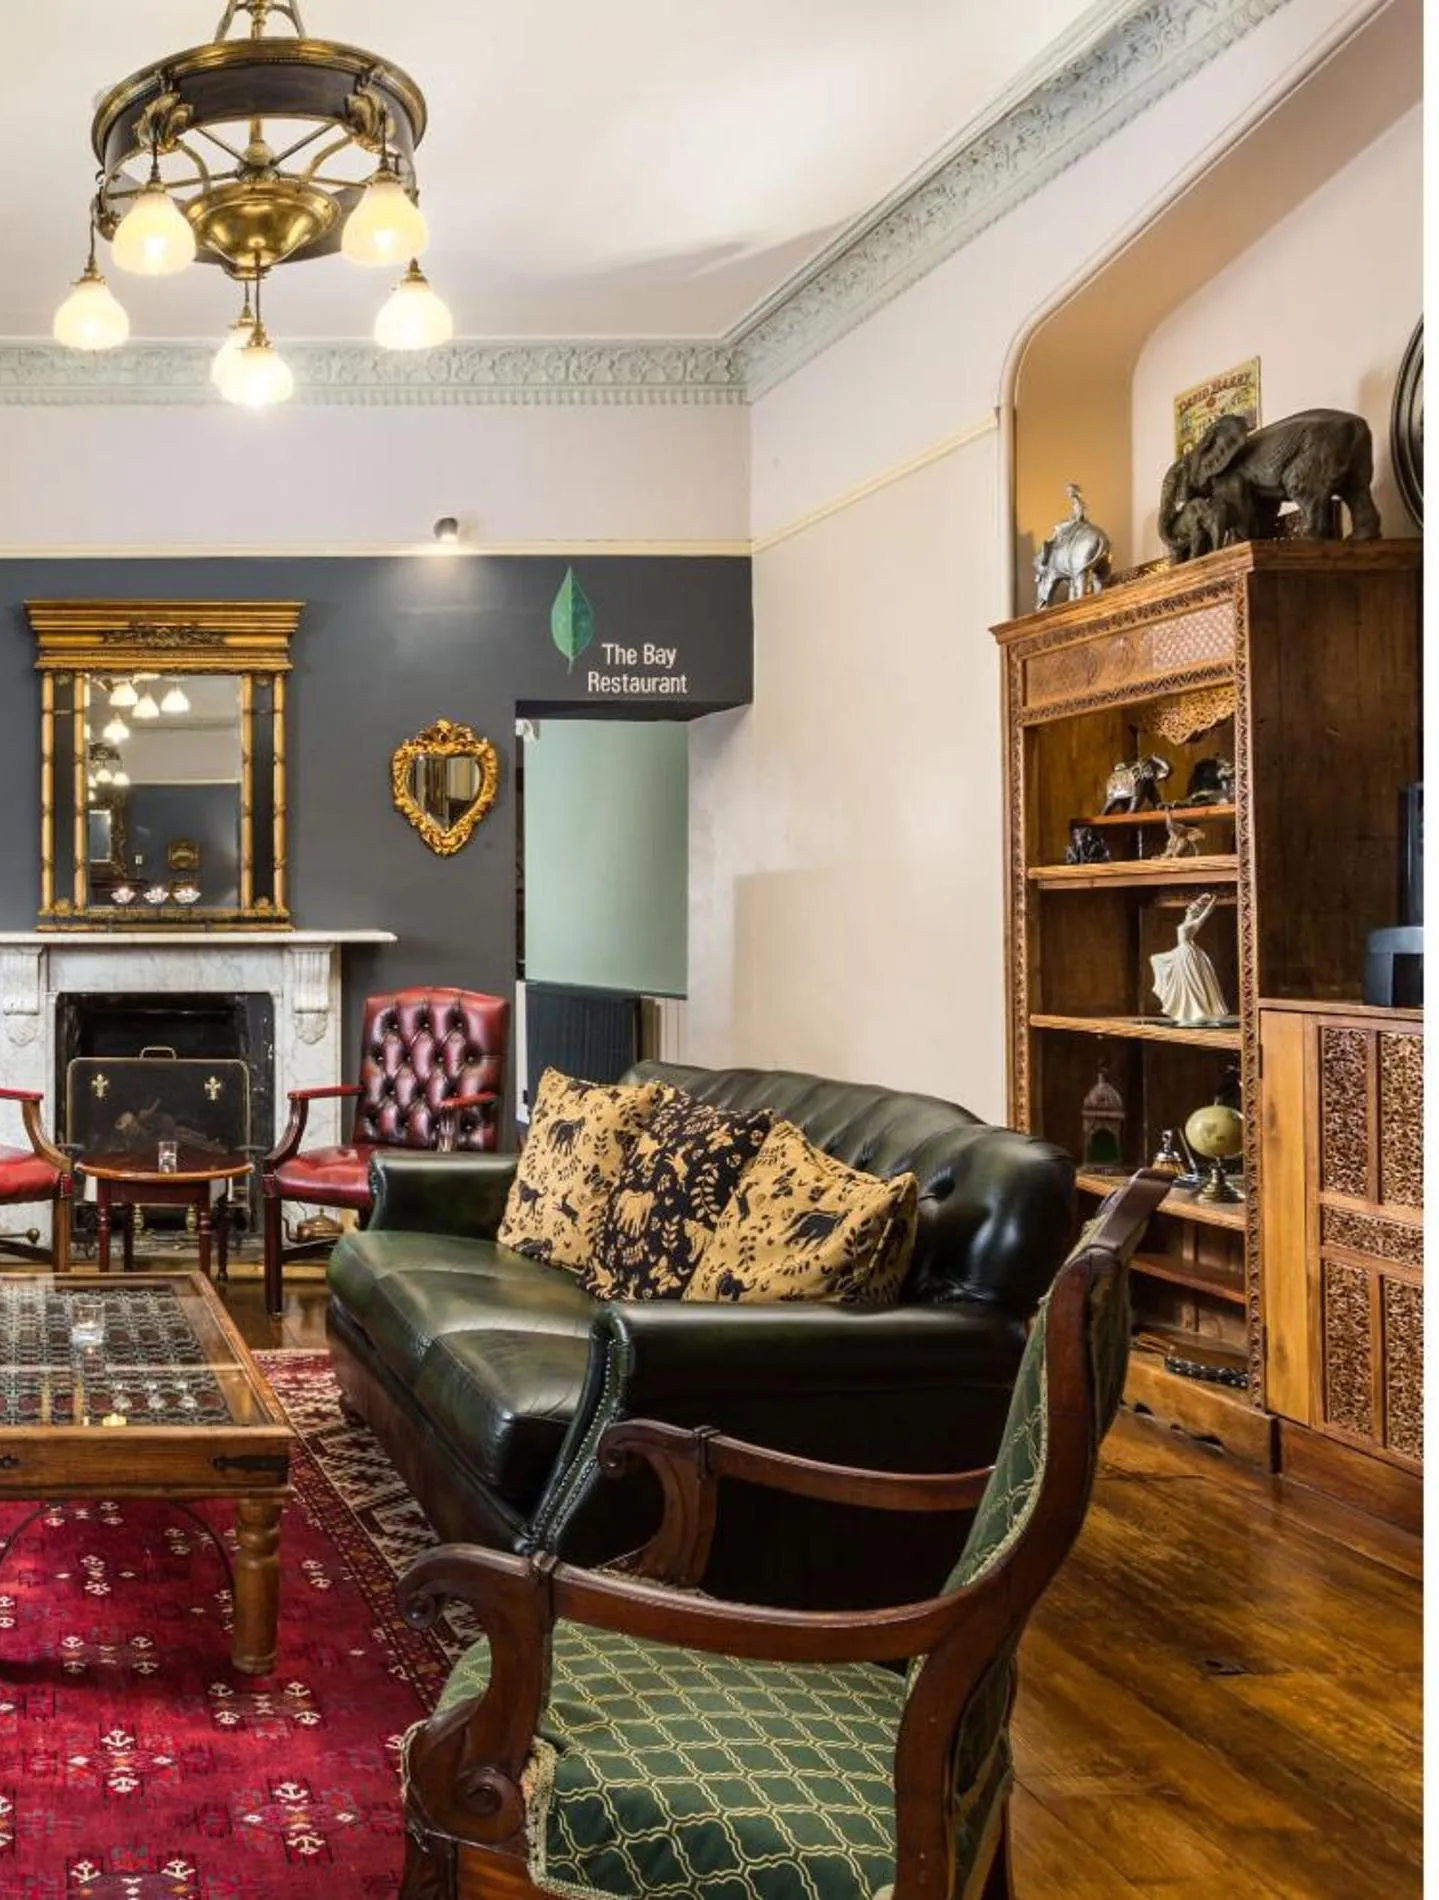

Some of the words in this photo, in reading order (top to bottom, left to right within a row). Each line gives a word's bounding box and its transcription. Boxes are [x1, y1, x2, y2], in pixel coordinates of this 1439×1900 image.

[601, 643, 637, 665] The
[643, 643, 677, 669] Bay
[588, 671, 688, 693] Restaurant
